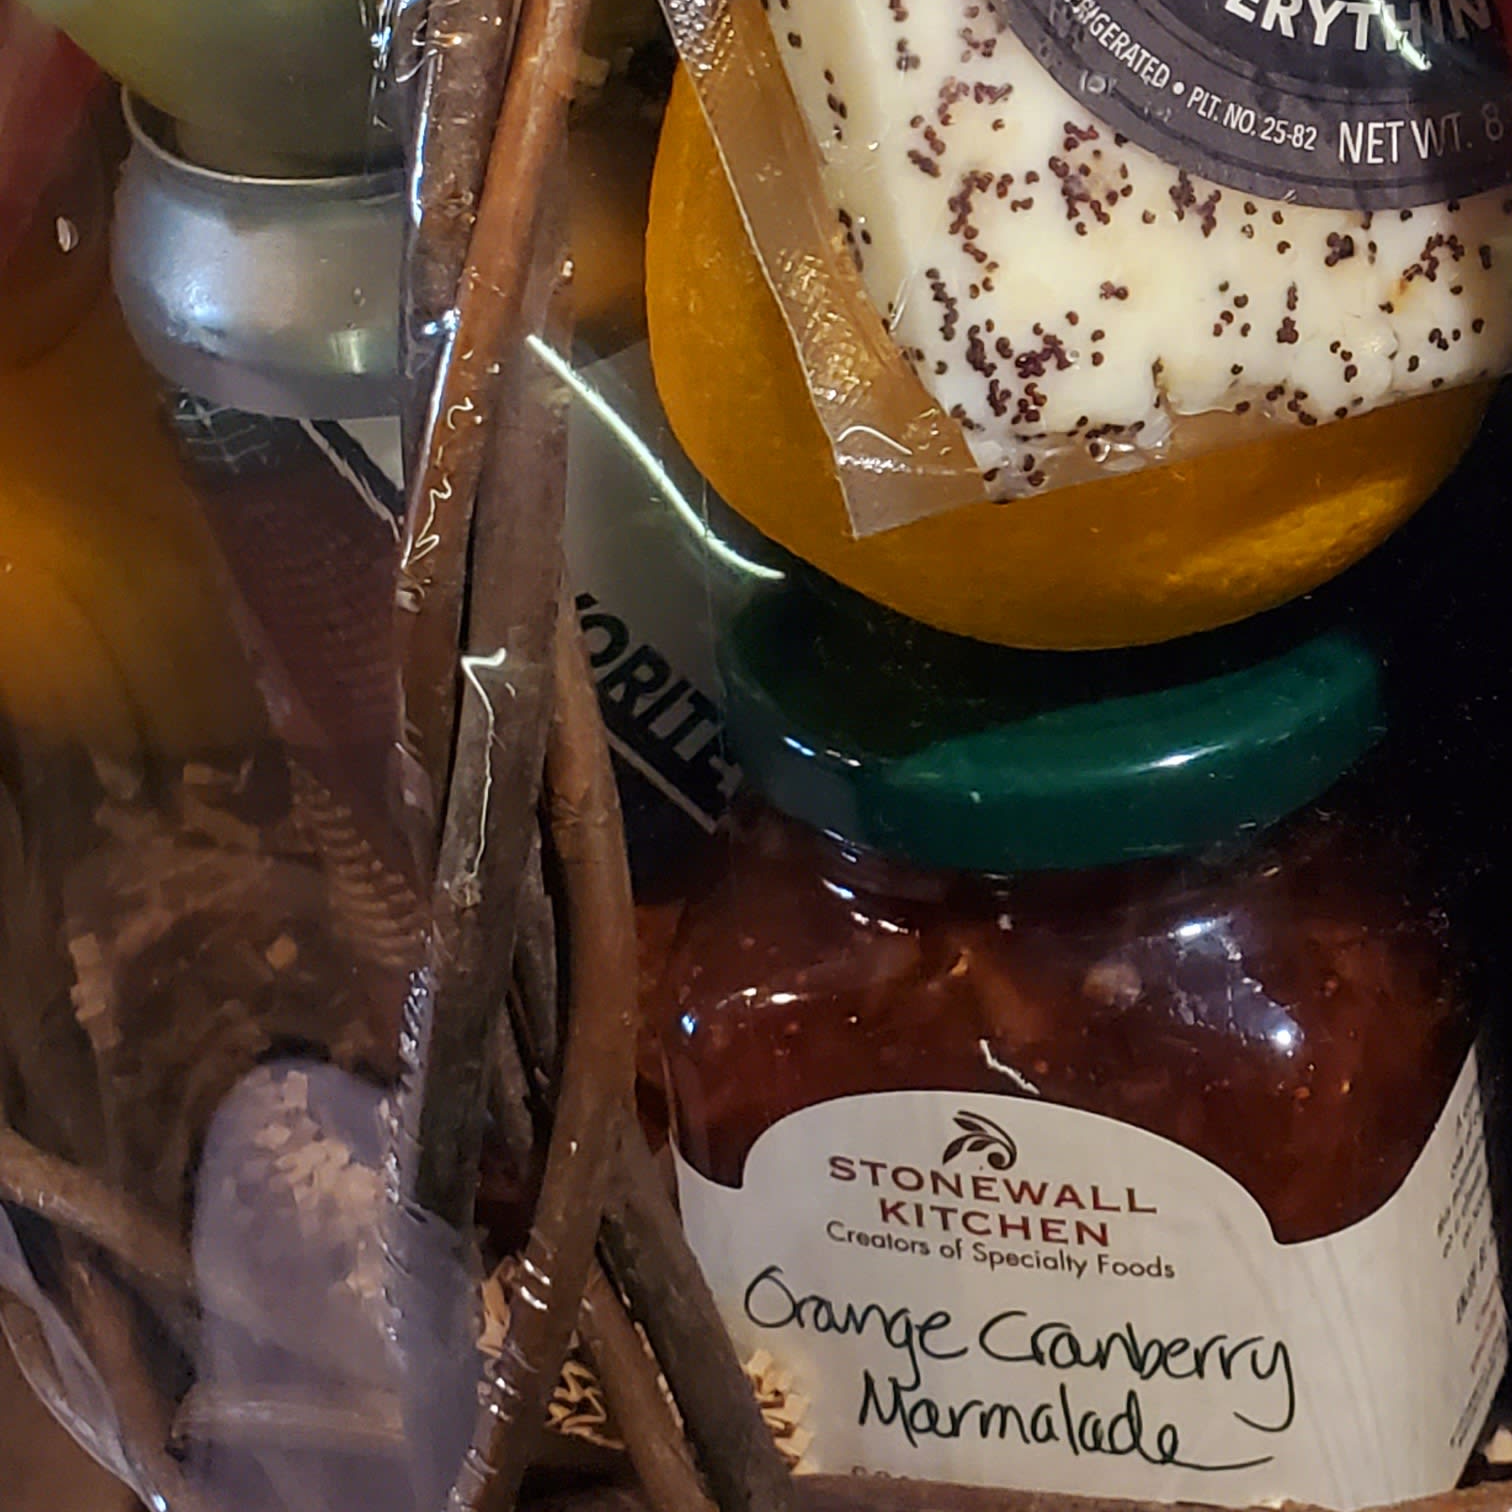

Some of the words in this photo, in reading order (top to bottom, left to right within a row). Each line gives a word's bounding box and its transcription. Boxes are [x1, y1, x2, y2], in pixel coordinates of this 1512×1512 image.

[1187, 86, 1221, 121] PLT.
[1223, 103, 1256, 136] NO.
[1260, 116, 1318, 151] 25-82
[1339, 120, 1404, 164] NET
[1410, 112, 1473, 159] WT.
[829, 1156, 1158, 1214] STONEWALL
[826, 1220, 930, 1256] Creators
[939, 1238, 963, 1260] of
[973, 1242, 1088, 1280] Specialty
[1098, 1254, 1176, 1279] Foods
[879, 1198, 1109, 1247] KITCHEN
[743, 1265, 968, 1392] Orange
[979, 1310, 1295, 1432] Cranberry
[858, 1369, 1275, 1472] Marmalade
